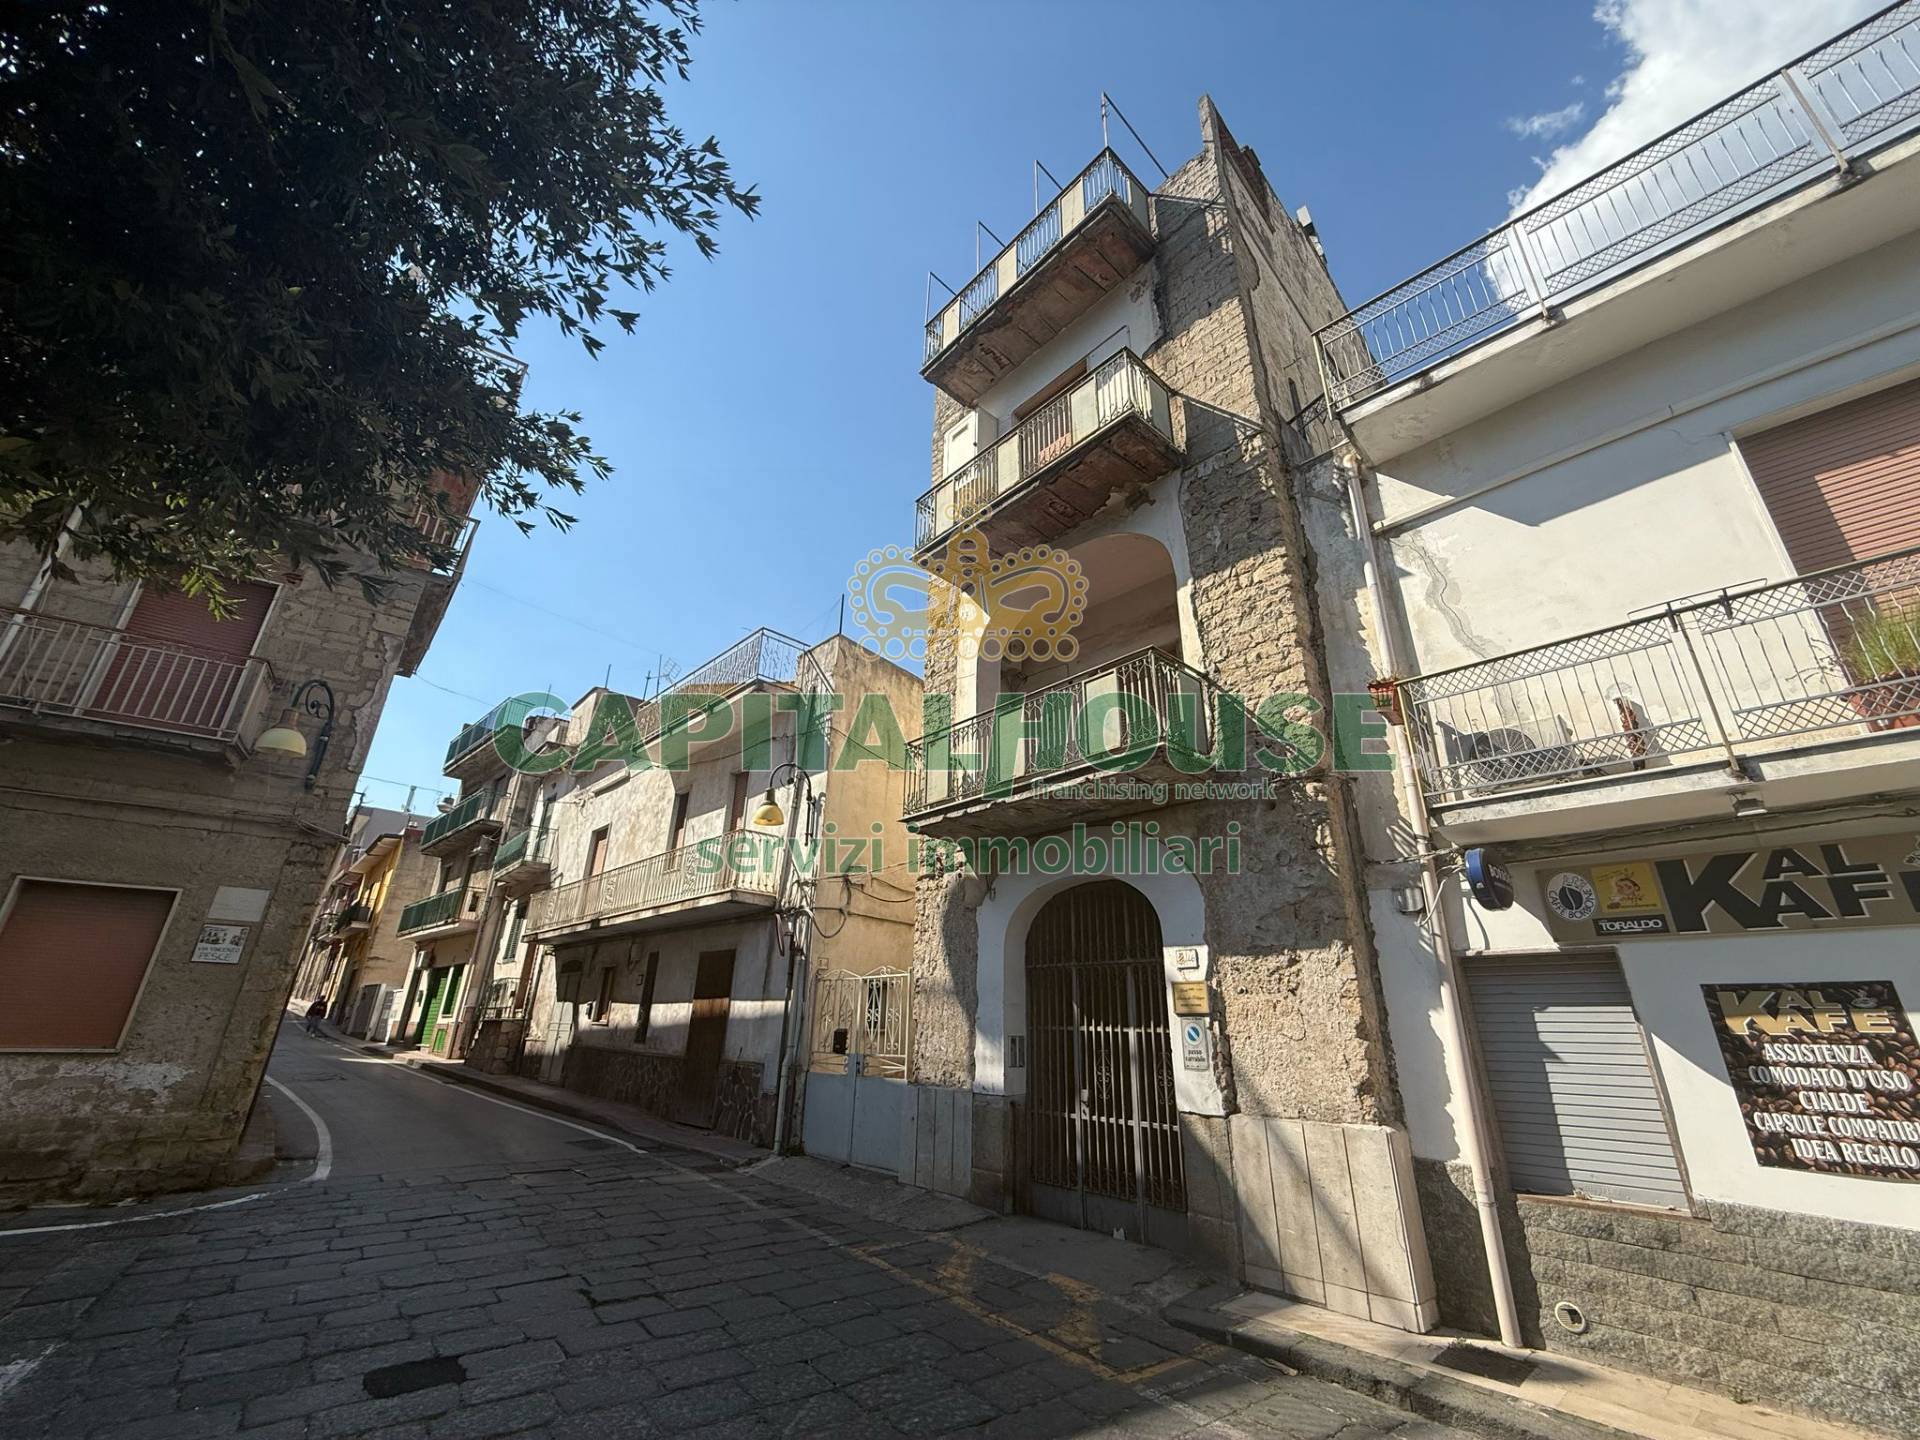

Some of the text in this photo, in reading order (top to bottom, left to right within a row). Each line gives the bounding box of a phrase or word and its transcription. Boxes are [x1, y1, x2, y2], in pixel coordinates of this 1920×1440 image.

[1599, 918, 1663, 931] TORALDO
[1764, 1043, 1874, 1064] ASSISTENZA
[1748, 1065, 1910, 1091] COMODATO D'USO
[1798, 1090, 1872, 1113] CIALDE
[1753, 1112, 1825, 1135] CAPSULE
[1790, 1138, 1919, 1169] IDEA REGALO
